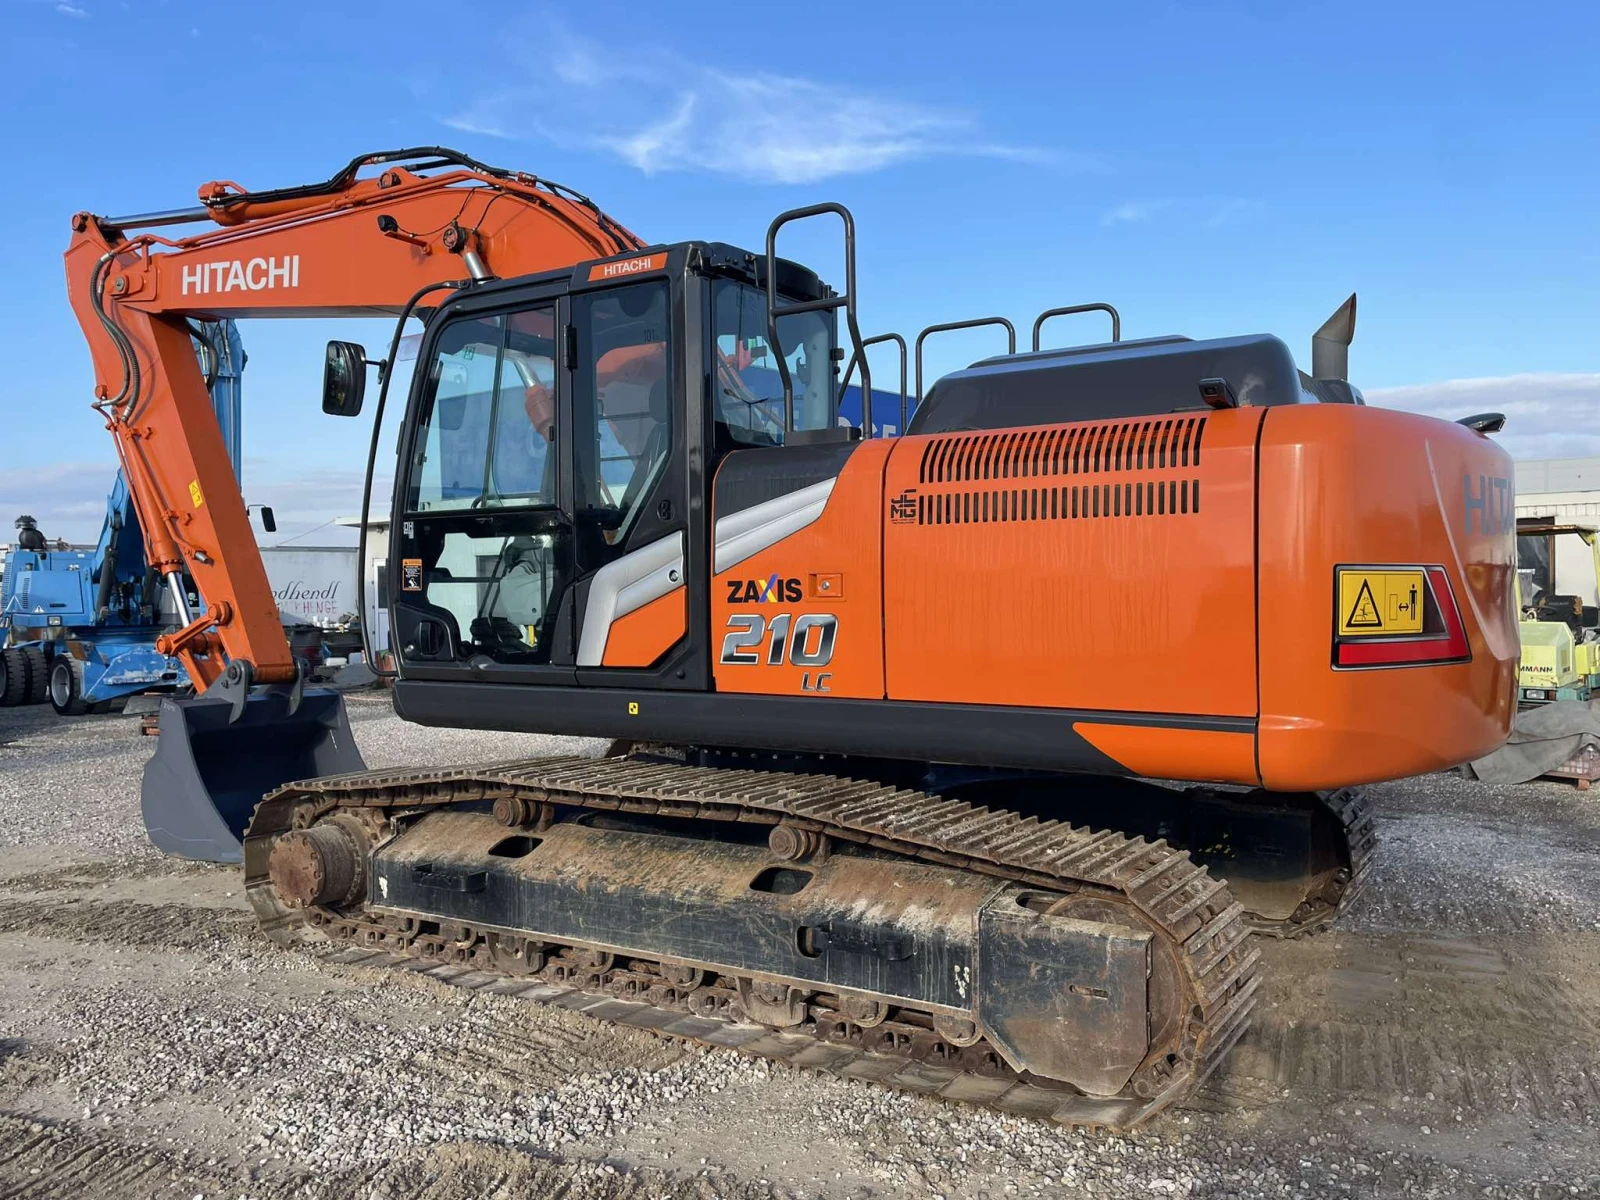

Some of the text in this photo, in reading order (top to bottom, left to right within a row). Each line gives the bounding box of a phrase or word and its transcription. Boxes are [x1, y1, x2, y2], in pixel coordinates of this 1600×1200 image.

[181, 254, 299, 296] HITACHI
[604, 257, 651, 276] HITACHI
[727, 573, 803, 603] ZAXIS
[720, 613, 839, 667] 210
[801, 672, 832, 692] LC
